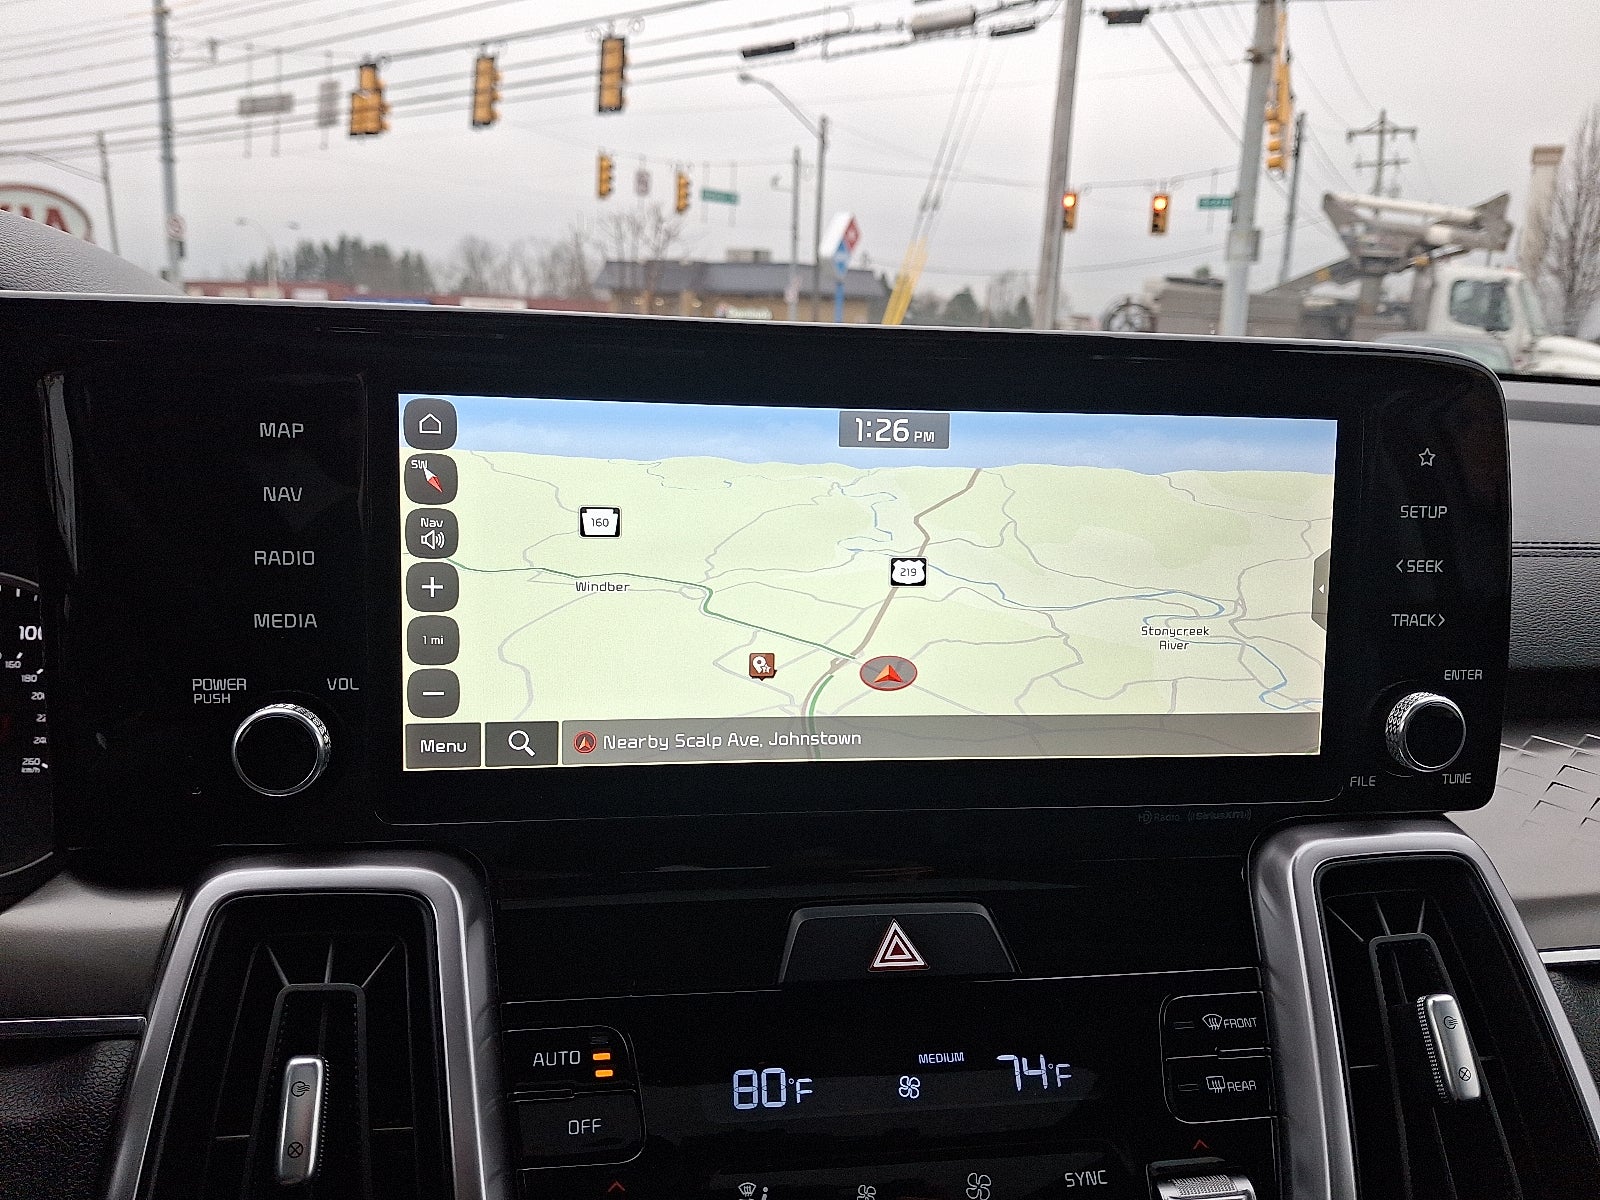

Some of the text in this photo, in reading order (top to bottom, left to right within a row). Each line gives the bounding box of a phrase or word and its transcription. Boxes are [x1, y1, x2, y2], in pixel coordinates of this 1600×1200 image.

[260, 423, 303, 438] MAP
[856, 418, 934, 442] 1:26 PM
[411, 460, 427, 470] SW
[264, 487, 302, 501] NAV
[1401, 505, 1447, 518] SETUP
[421, 518, 443, 527] Nav
[591, 518, 610, 527] 160
[255, 551, 314, 565] RADIO
[901, 568, 916, 576] 219
[1407, 560, 1443, 572] SEEK
[576, 582, 630, 591] Windber
[254, 614, 317, 628] MEDIA
[1391, 614, 1436, 626] TRACK
[1141, 625, 1209, 638] Stonycreek
[422, 635, 443, 645] 1 mi
[1159, 639, 1190, 650] River
[21, 674, 38, 683] 180
[1444, 670, 1482, 680] ENTER
[193, 678, 246, 691] POWER
[327, 678, 359, 690] VOL
[194, 694, 230, 704] PUSH
[421, 740, 466, 752] Menu
[604, 732, 861, 750] Nearby Scalp Ave, Johnstown
[22, 757, 40, 766] 260
[1350, 776, 1376, 787] FILE
[1442, 773, 1471, 784] TUNE
[1224, 1018, 1256, 1028] FRONT
[533, 1051, 580, 1066] AUTO
[919, 1052, 964, 1064] MEDIUM
[1227, 1080, 1256, 1092] REAR
[569, 1119, 601, 1134] OFF
[1065, 1170, 1107, 1187] SYNC
